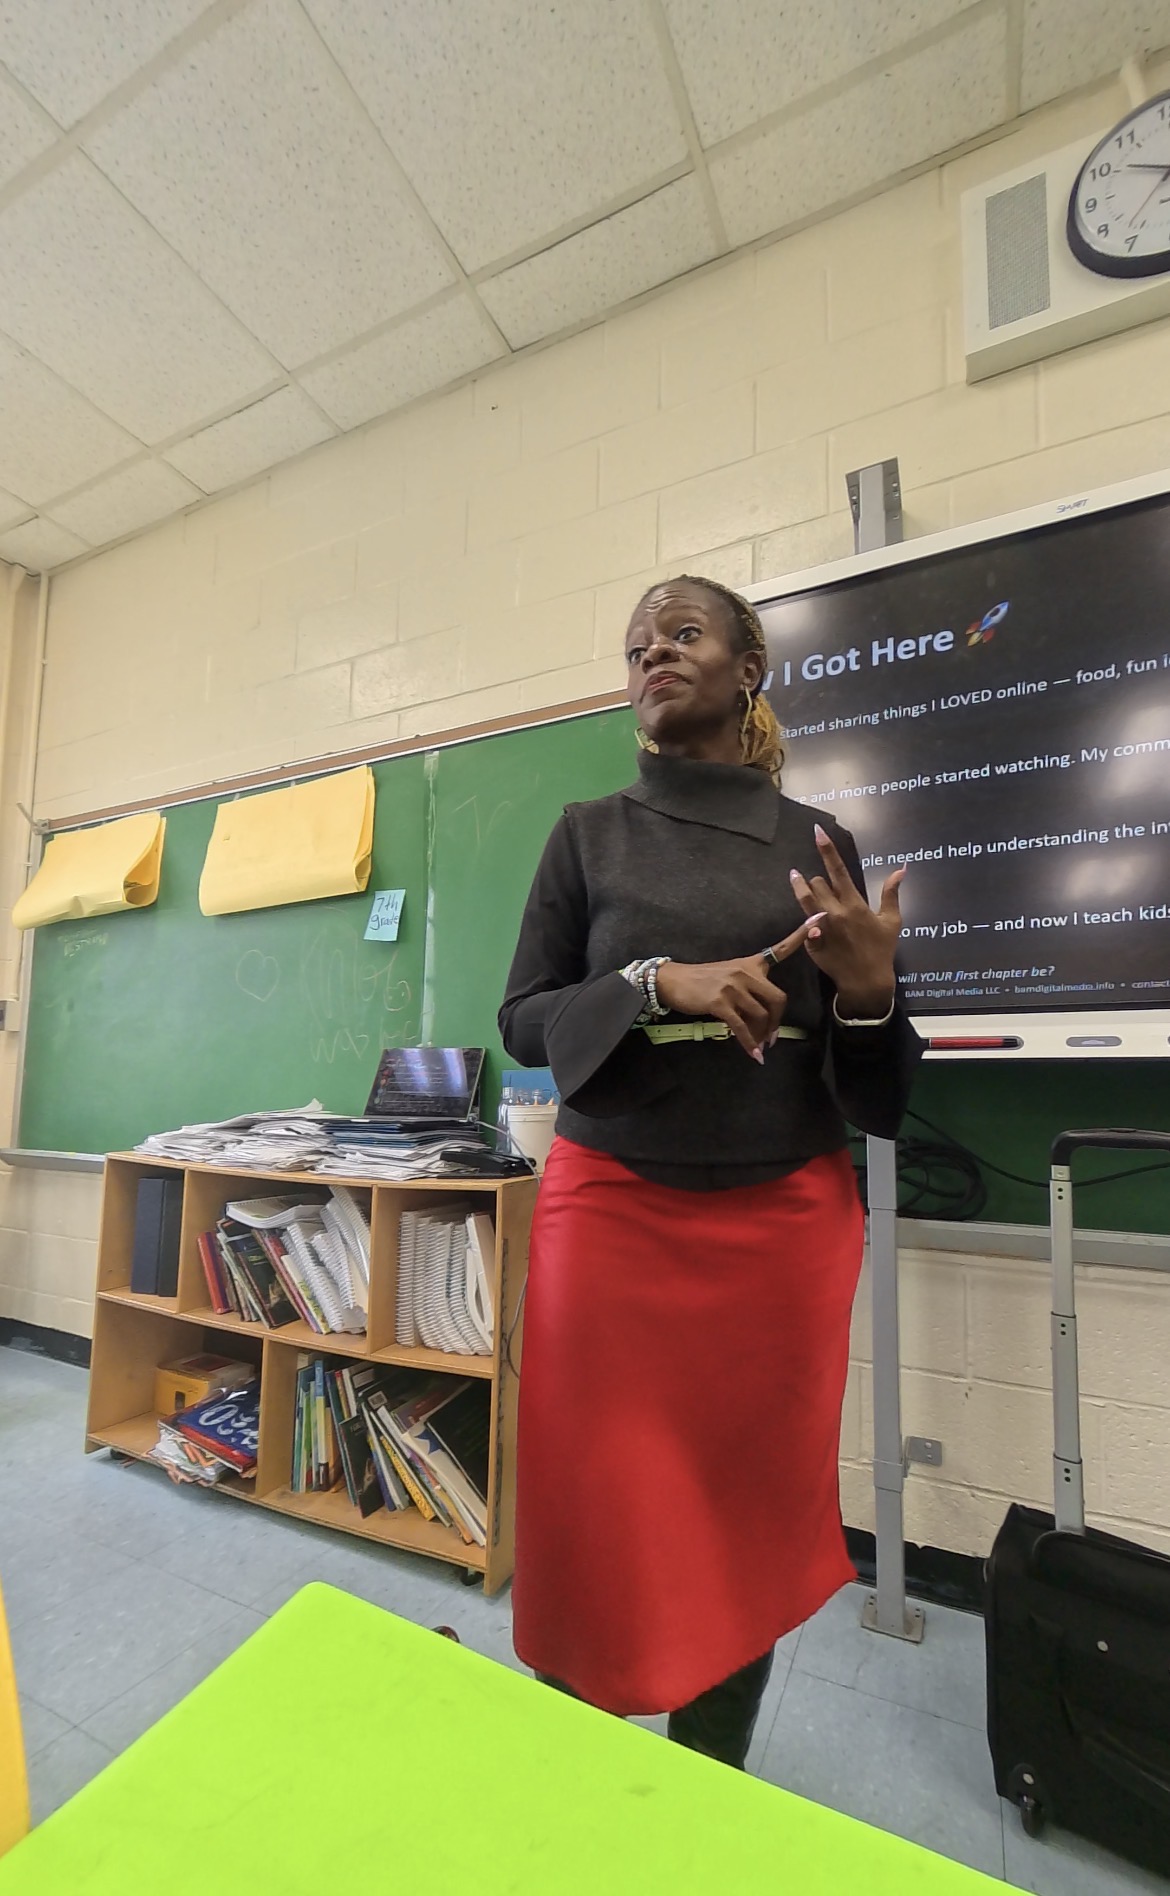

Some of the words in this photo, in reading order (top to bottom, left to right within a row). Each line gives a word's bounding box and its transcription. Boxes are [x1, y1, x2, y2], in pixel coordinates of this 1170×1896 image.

[1115, 129, 1135, 149] 11
[1089, 162, 1111, 182] 10
[1085, 198, 1097, 214] 9
[1096, 223, 1110, 239] 8
[1124, 234, 1139, 253] 7
[784, 661, 792, 687] I
[801, 647, 861, 681] Got
[871, 629, 955, 667] Here
[779, 720, 825, 740] started
[828, 708, 880, 731] sharing
[883, 699, 928, 722] things
[931, 699, 936, 712] I
[941, 689, 992, 709] LOVED
[996, 678, 1048, 699] online
[1076, 663, 1121, 684] food,
[1126, 658, 1157, 675] fun
[810, 788, 835, 804] and
[839, 784, 877, 800] more
[881, 773, 931, 796] people
[934, 763, 991, 786] started
[995, 753, 1076, 775] watching.
[1081, 747, 1108, 763] My
[861, 854, 883, 870] ple
[887, 845, 943, 865] needed
[948, 841, 982, 858] help
[987, 828, 1109, 854] understanding
[1114, 823, 1146, 839] the
[377, 894, 399, 913] 7th
[898, 928, 911, 938] o
[915, 926, 938, 939] my
[941, 920, 968, 938] job
[994, 916, 1025, 931] and
[1030, 915, 1068, 928] now
[1073, 912, 1078, 926] I
[1083, 907, 1133, 924] teach
[898, 972, 918, 984] will
[920, 971, 953, 983] YOUR
[953, 969, 979, 983] first
[981, 967, 1028, 981] chapter
[1031, 965, 1056, 977] be?
[926, 988, 954, 998] Digital
[955, 987, 983, 996] Media
[985, 986, 1001, 995] LLC
